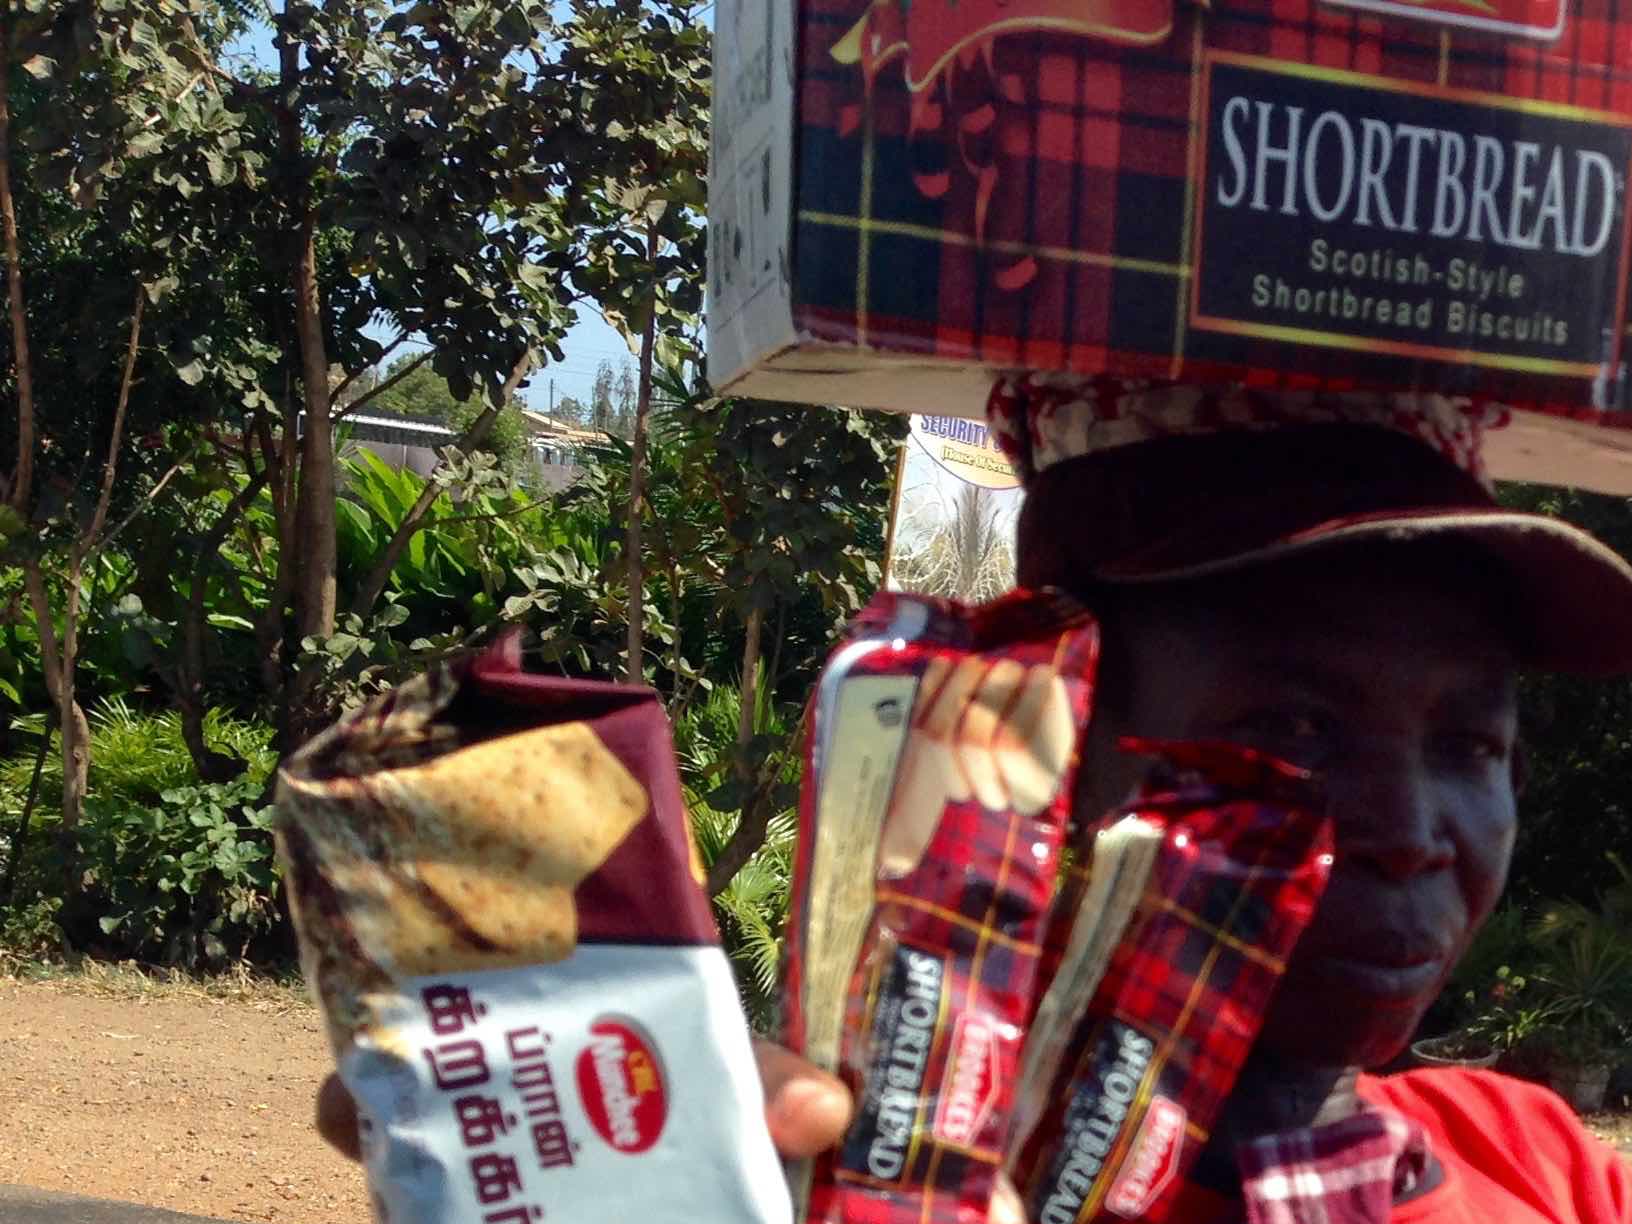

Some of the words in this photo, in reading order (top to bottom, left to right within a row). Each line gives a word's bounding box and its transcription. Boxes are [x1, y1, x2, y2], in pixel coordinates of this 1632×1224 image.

[1218, 95, 1620, 258] SHORTBREAD
[1251, 275, 1434, 329] Shortbread
[1447, 301, 1569, 346] Biscuits
[1308, 240, 1526, 300] Scotish-Style
[921, 416, 991, 449] SECURITY
[588, 1026, 641, 1149] Munchee
[868, 948, 942, 1181] SHORTBREAD
